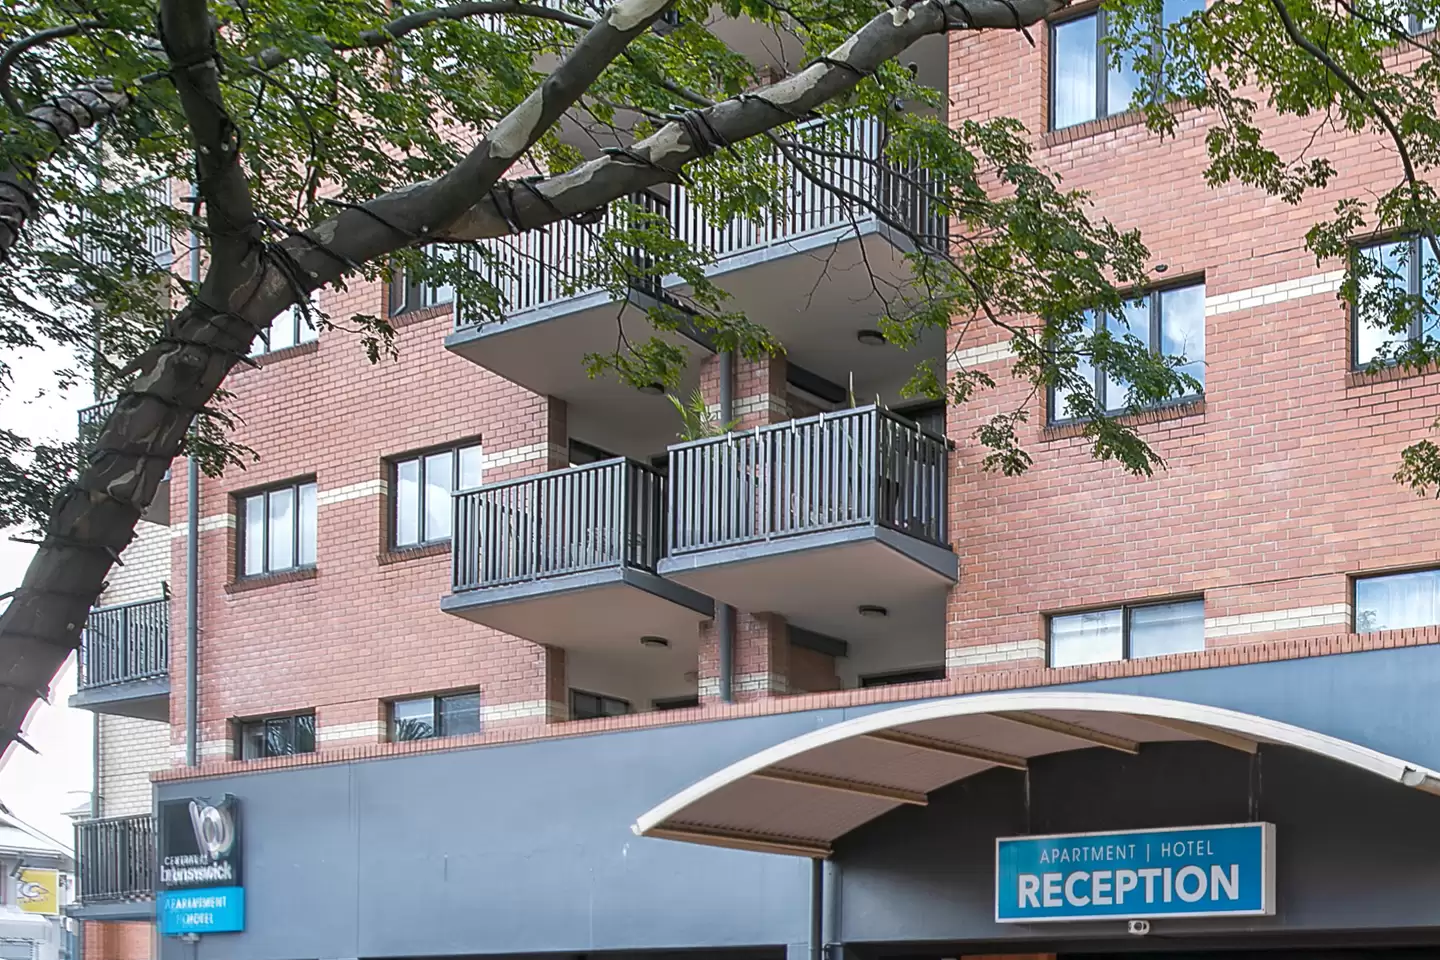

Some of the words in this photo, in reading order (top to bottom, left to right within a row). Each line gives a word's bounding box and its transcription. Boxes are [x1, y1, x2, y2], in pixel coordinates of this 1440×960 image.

[1040, 844, 1136, 864] APARTMENT
[1161, 840, 1213, 858] HOTEL
[1018, 864, 1240, 908] RECEPTION
